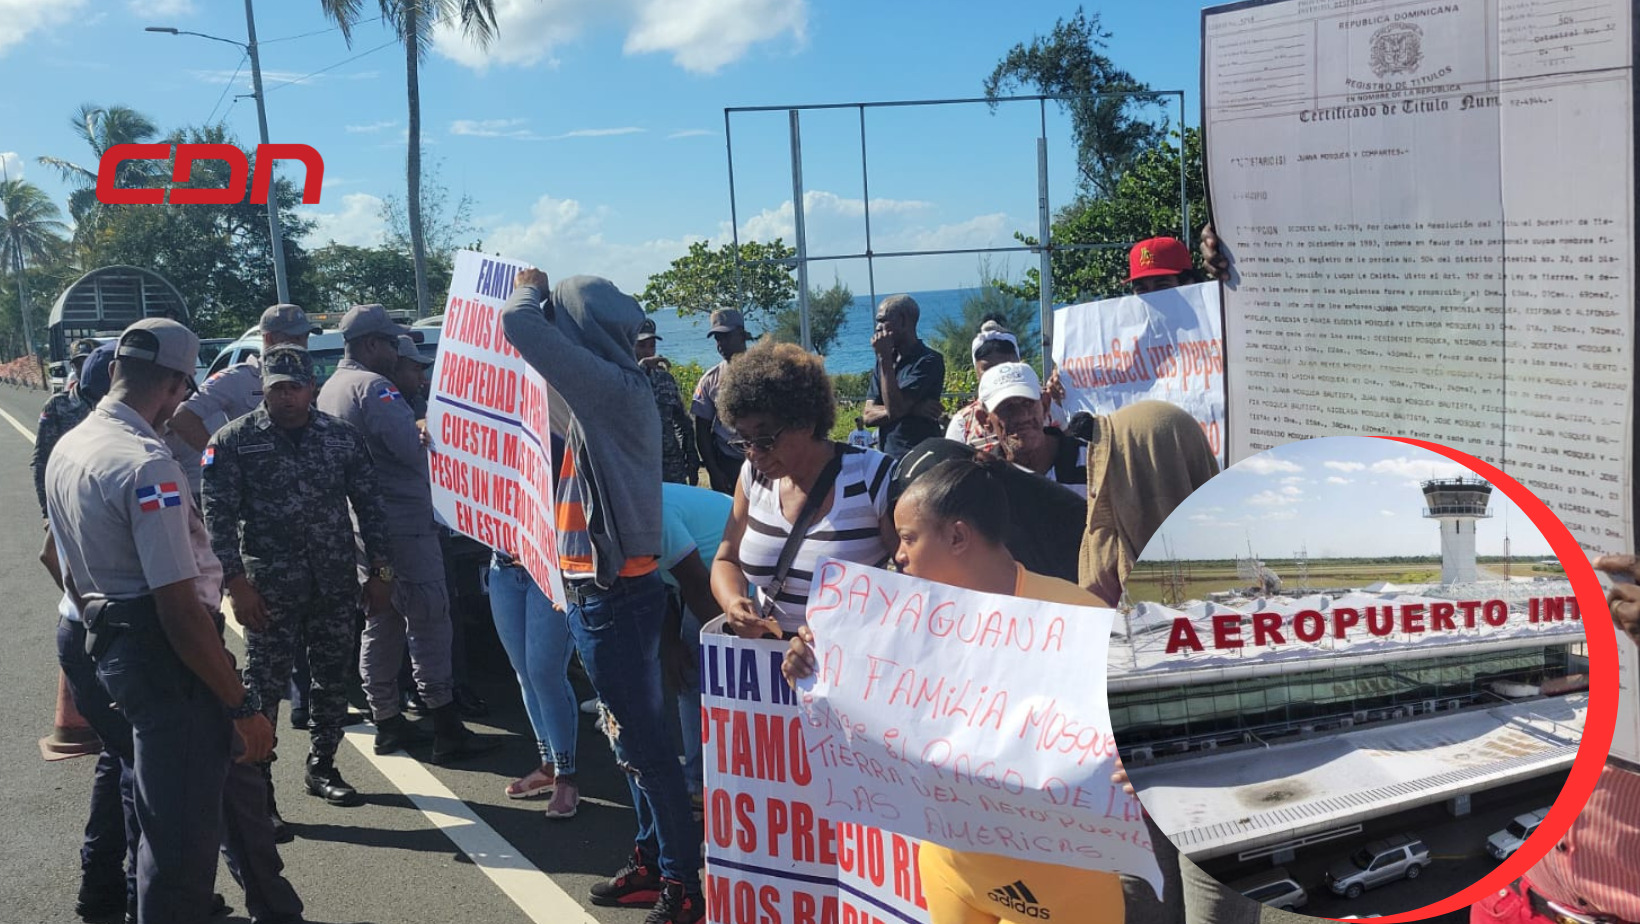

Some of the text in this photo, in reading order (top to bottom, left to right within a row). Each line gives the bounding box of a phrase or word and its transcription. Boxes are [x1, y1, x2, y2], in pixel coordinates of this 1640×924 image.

[1338, 4, 1460, 29] REPUBLICA DOMINICANA
[1345, 65, 1453, 91] REGISTRO DE TITULOS
[1357, 92, 1390, 102] NOMBRE
[1392, 91, 1402, 99] DE
[1404, 90, 1414, 98] LA
[1299, 104, 1377, 123] Certificado
[1381, 101, 1396, 116] de
[1402, 97, 1449, 115] Titulo
[445, 296, 463, 340] 67
[458, 298, 494, 351] AÑOS
[439, 350, 517, 414] PROPIEDAD
[442, 412, 498, 463] CUESTA
[430, 450, 469, 498] PESOS
[472, 466, 489, 507] UN
[456, 500, 474, 536] EN
[476, 508, 519, 557] ESTOS
[807, 561, 1065, 652] BAYAGUANA
[1165, 599, 1508, 654] AEROPUERTO
[826, 778, 900, 820] LAS
[921, 739, 1024, 795] PAGO
[1042, 776, 1092, 809] DE
[704, 787, 757, 854] OS
[768, 797, 885, 888] PRECIO
[988, 888, 1051, 920] adidas
